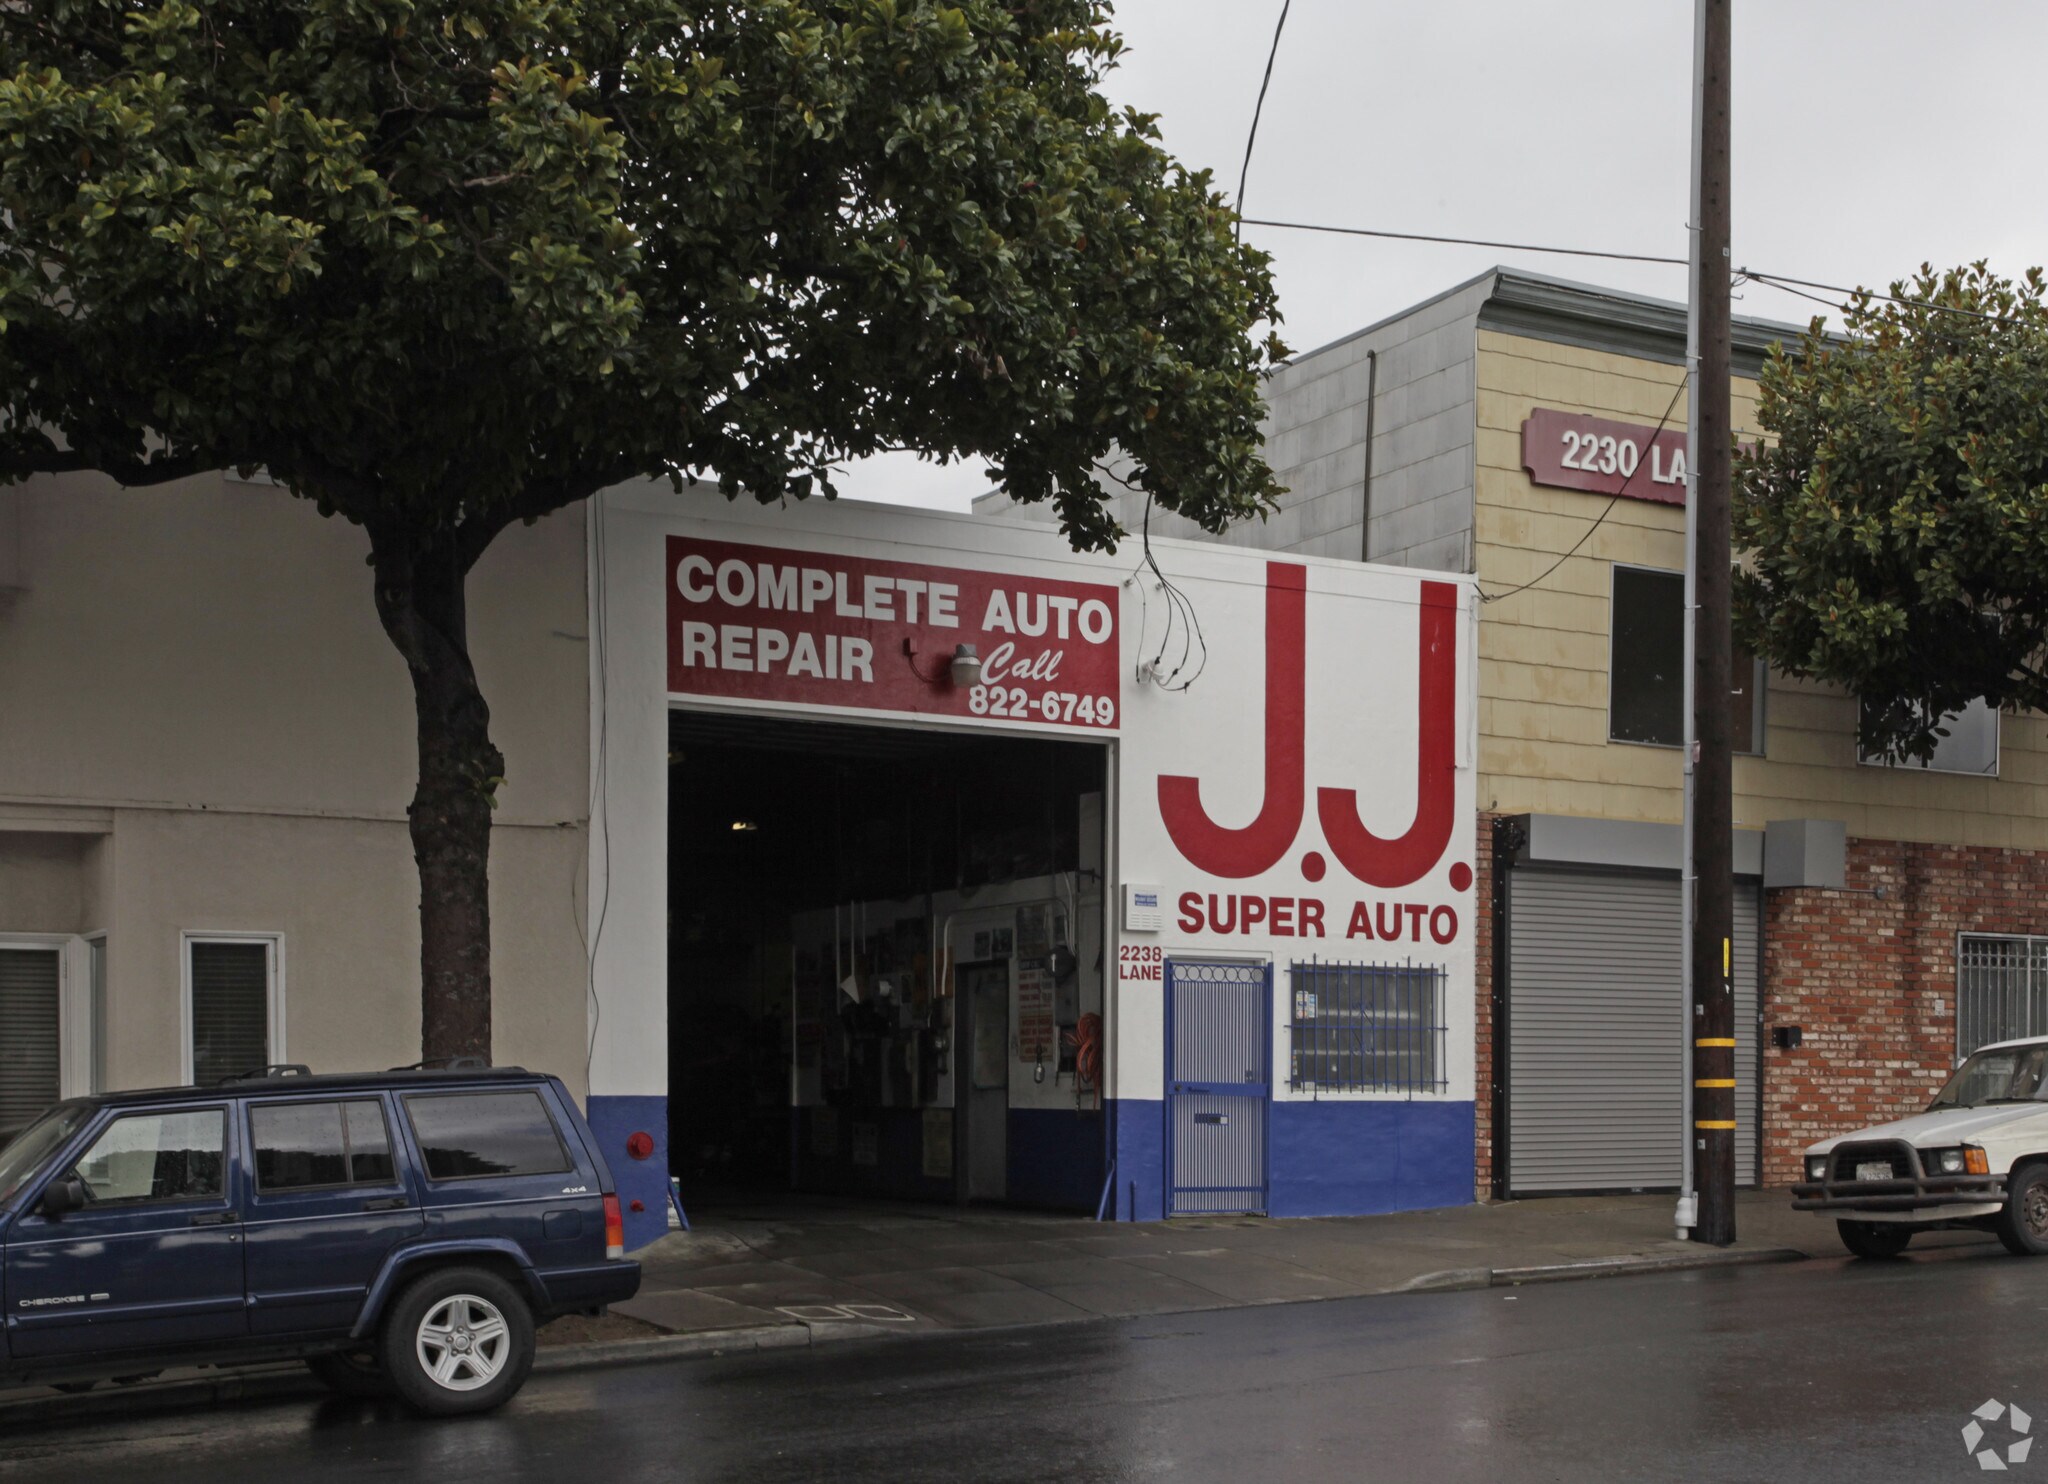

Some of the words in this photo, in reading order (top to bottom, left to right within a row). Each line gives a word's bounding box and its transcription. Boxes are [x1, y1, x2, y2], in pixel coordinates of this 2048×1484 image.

[1561, 430, 1638, 478] 2230
[1652, 445, 1687, 486] LA
[676, 554, 959, 628] COMPLETE
[982, 589, 1113, 644] AUTO
[682, 620, 874, 683] REPAIR
[980, 641, 1064, 685] Call
[969, 684, 1115, 726] 822-6749
[1178, 892, 1326, 938] SUPER
[1346, 901, 1458, 945] AUTO
[1119, 964, 1162, 980] LANE
[1120, 945, 1162, 962] 2238
[19, 1295, 85, 1306] CHEROKEE
